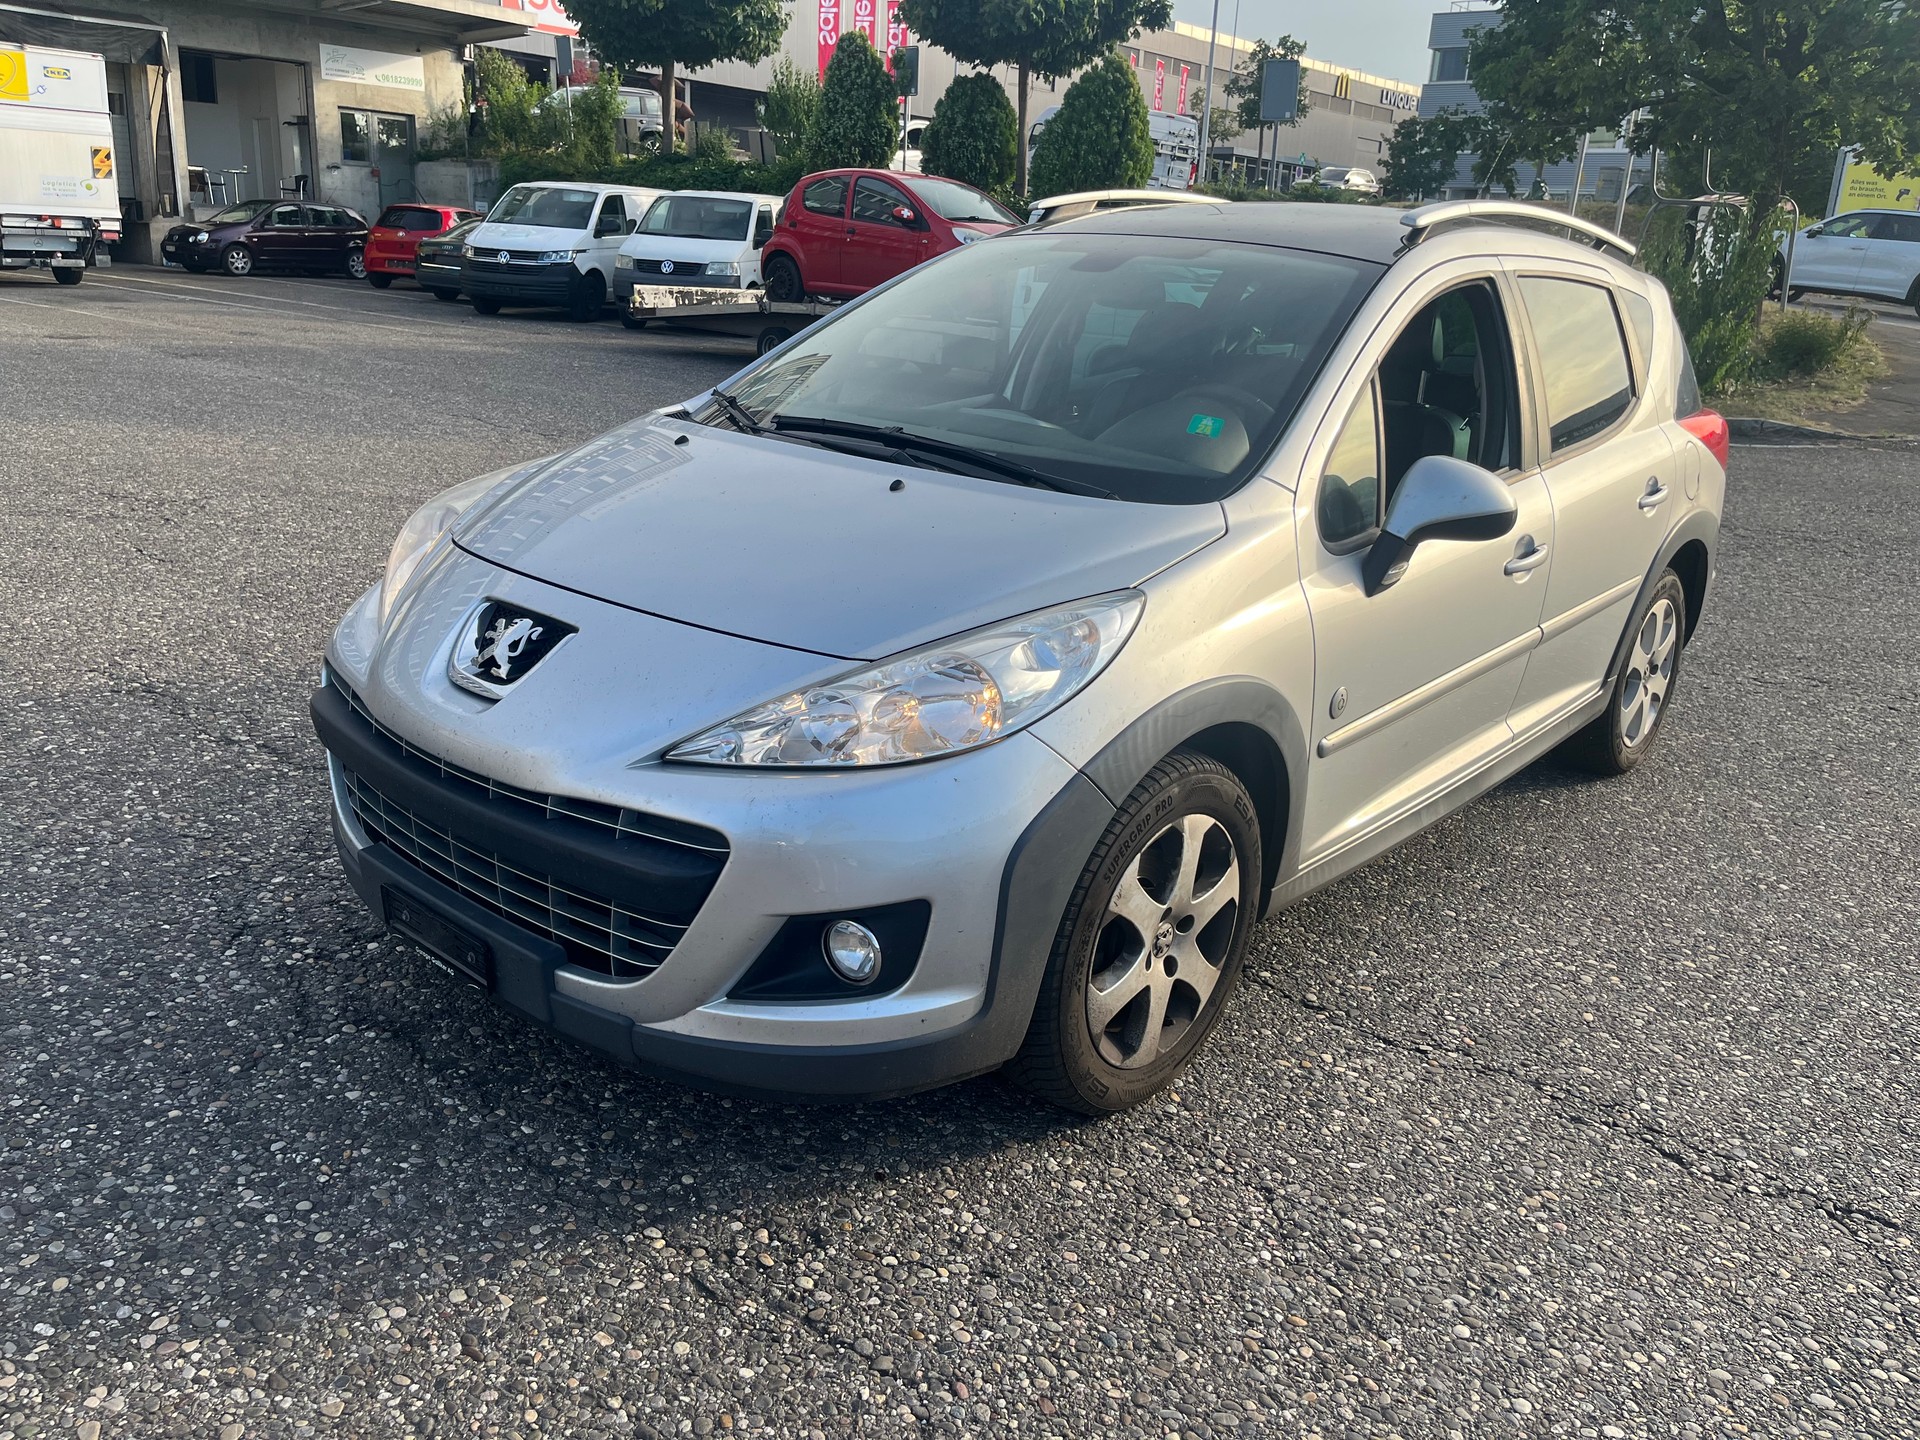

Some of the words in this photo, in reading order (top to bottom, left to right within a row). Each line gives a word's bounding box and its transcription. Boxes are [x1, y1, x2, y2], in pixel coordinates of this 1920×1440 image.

[855, 0, 874, 34] ale
[46, 69, 69, 77] IKEA
[381, 74, 423, 87] 0618239990
[1103, 813, 1152, 884] SUPERGRIP
[1154, 795, 1173, 817] PRO
